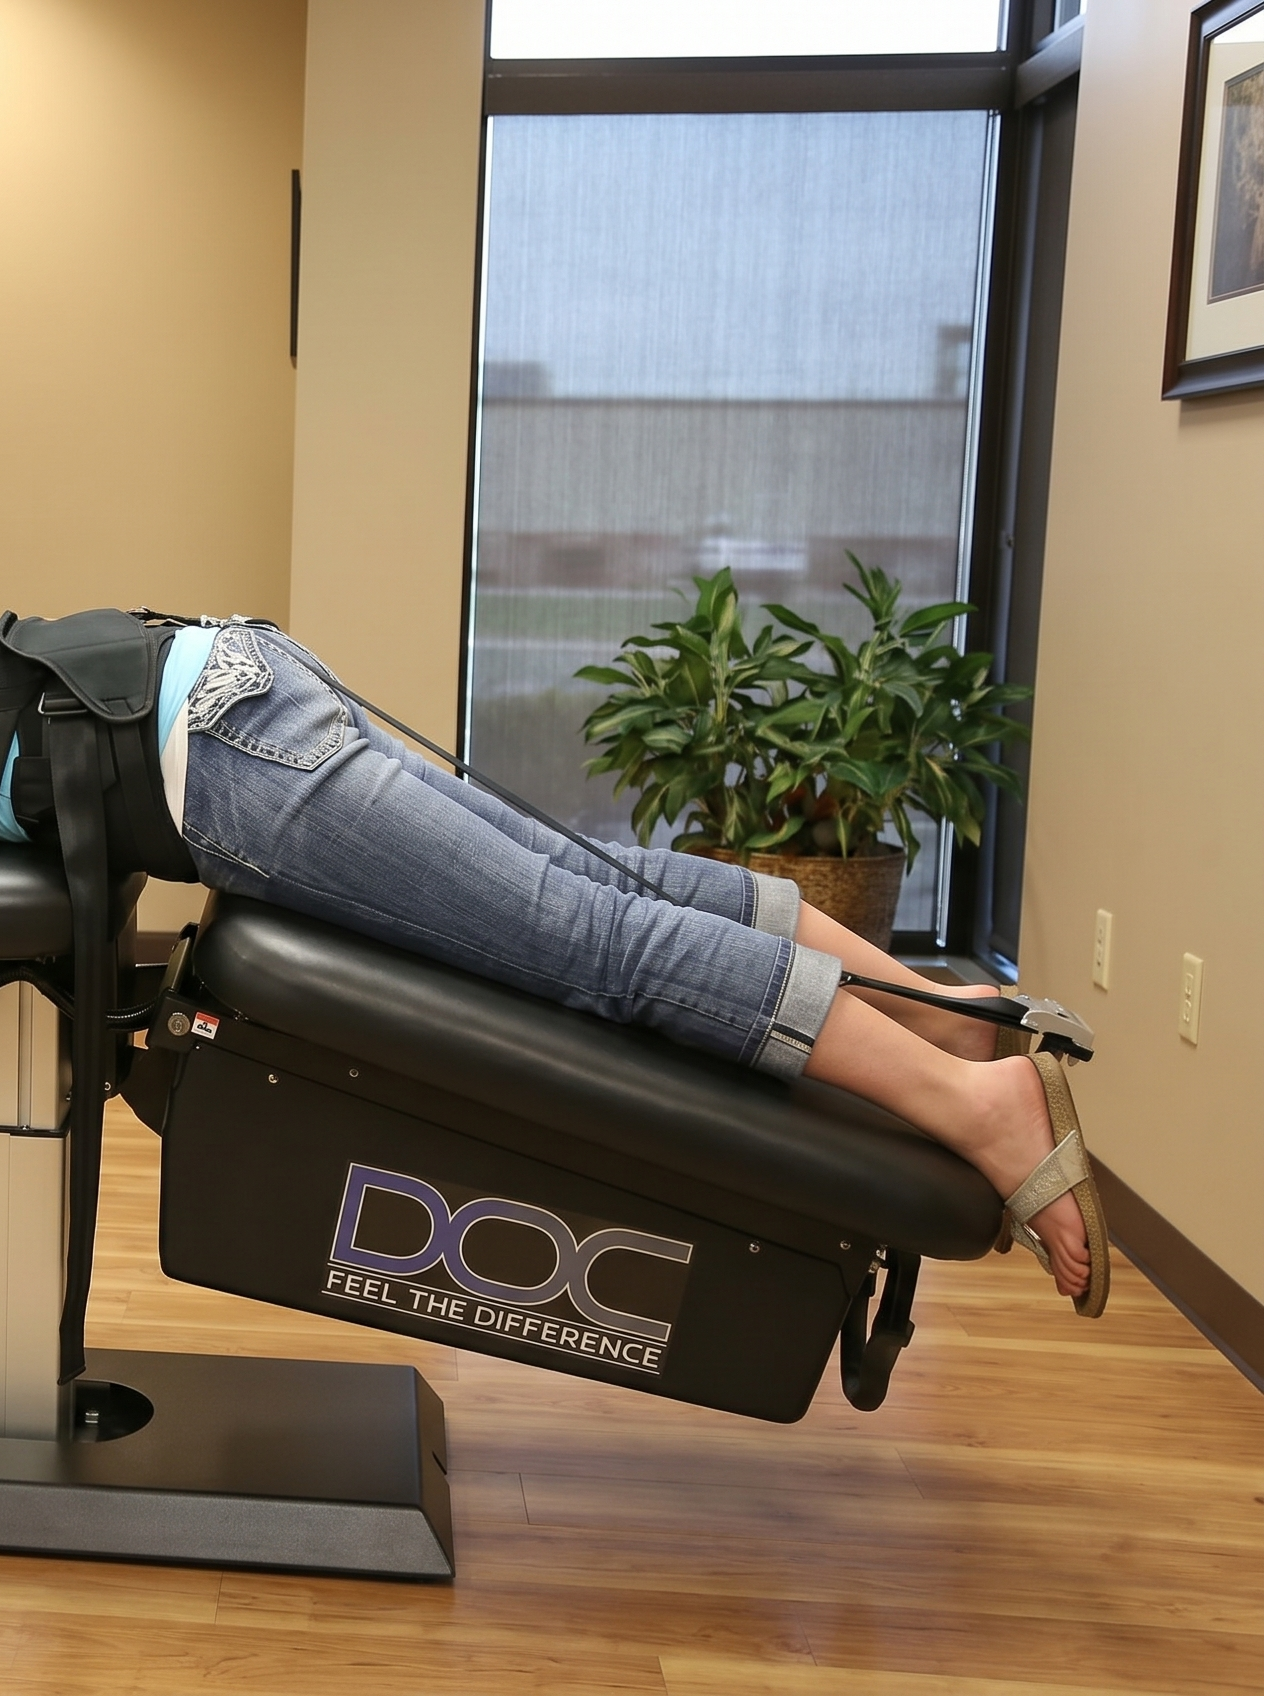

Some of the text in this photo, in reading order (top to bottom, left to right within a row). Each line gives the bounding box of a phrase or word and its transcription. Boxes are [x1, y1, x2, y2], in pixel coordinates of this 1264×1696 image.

[326, 1269, 662, 1369] FEEL THE DIFFERENCE
[330, 1162, 694, 1342] DOC
